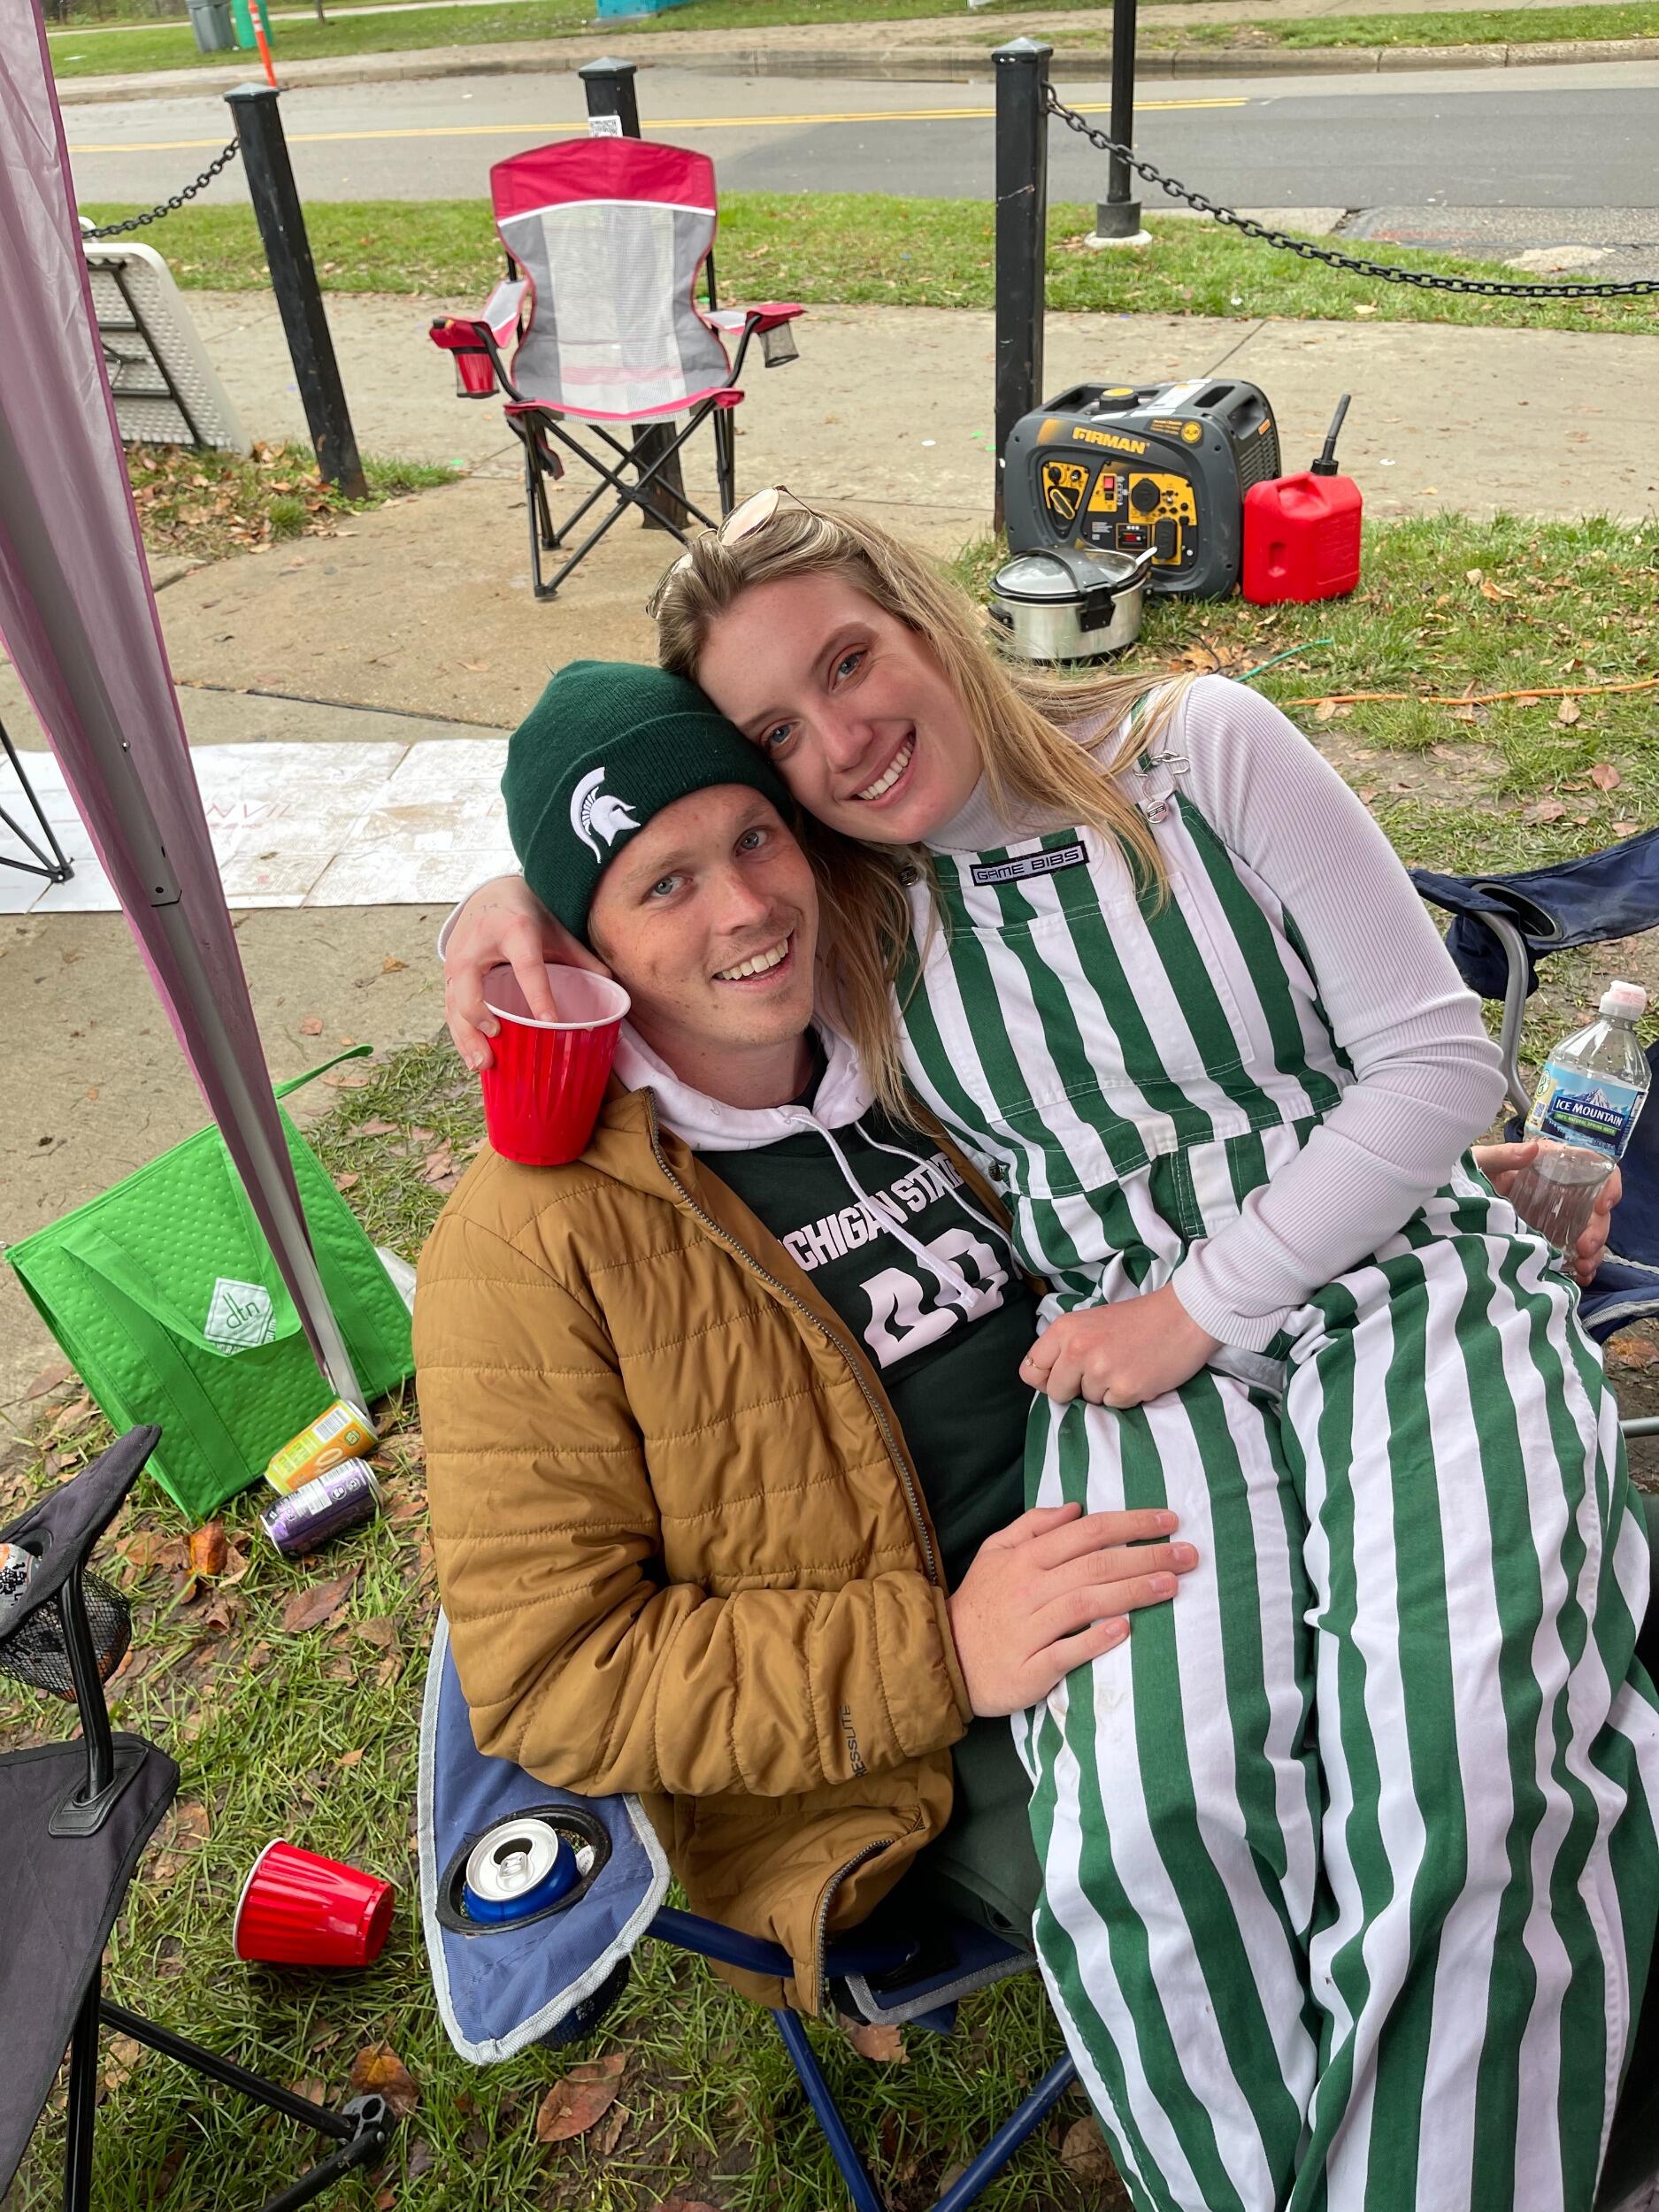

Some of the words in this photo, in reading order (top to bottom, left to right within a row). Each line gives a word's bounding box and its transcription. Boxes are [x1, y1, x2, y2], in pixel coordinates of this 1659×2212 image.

[1072, 426, 1146, 455] FIRMAN
[977, 864, 1025, 880] GAME
[1031, 849, 1079, 871] BIBS
[1555, 1099, 1572, 1111] ICE
[1571, 1102, 1623, 1126] MOUNTAIN
[779, 1190, 909, 1271] CHIGAN
